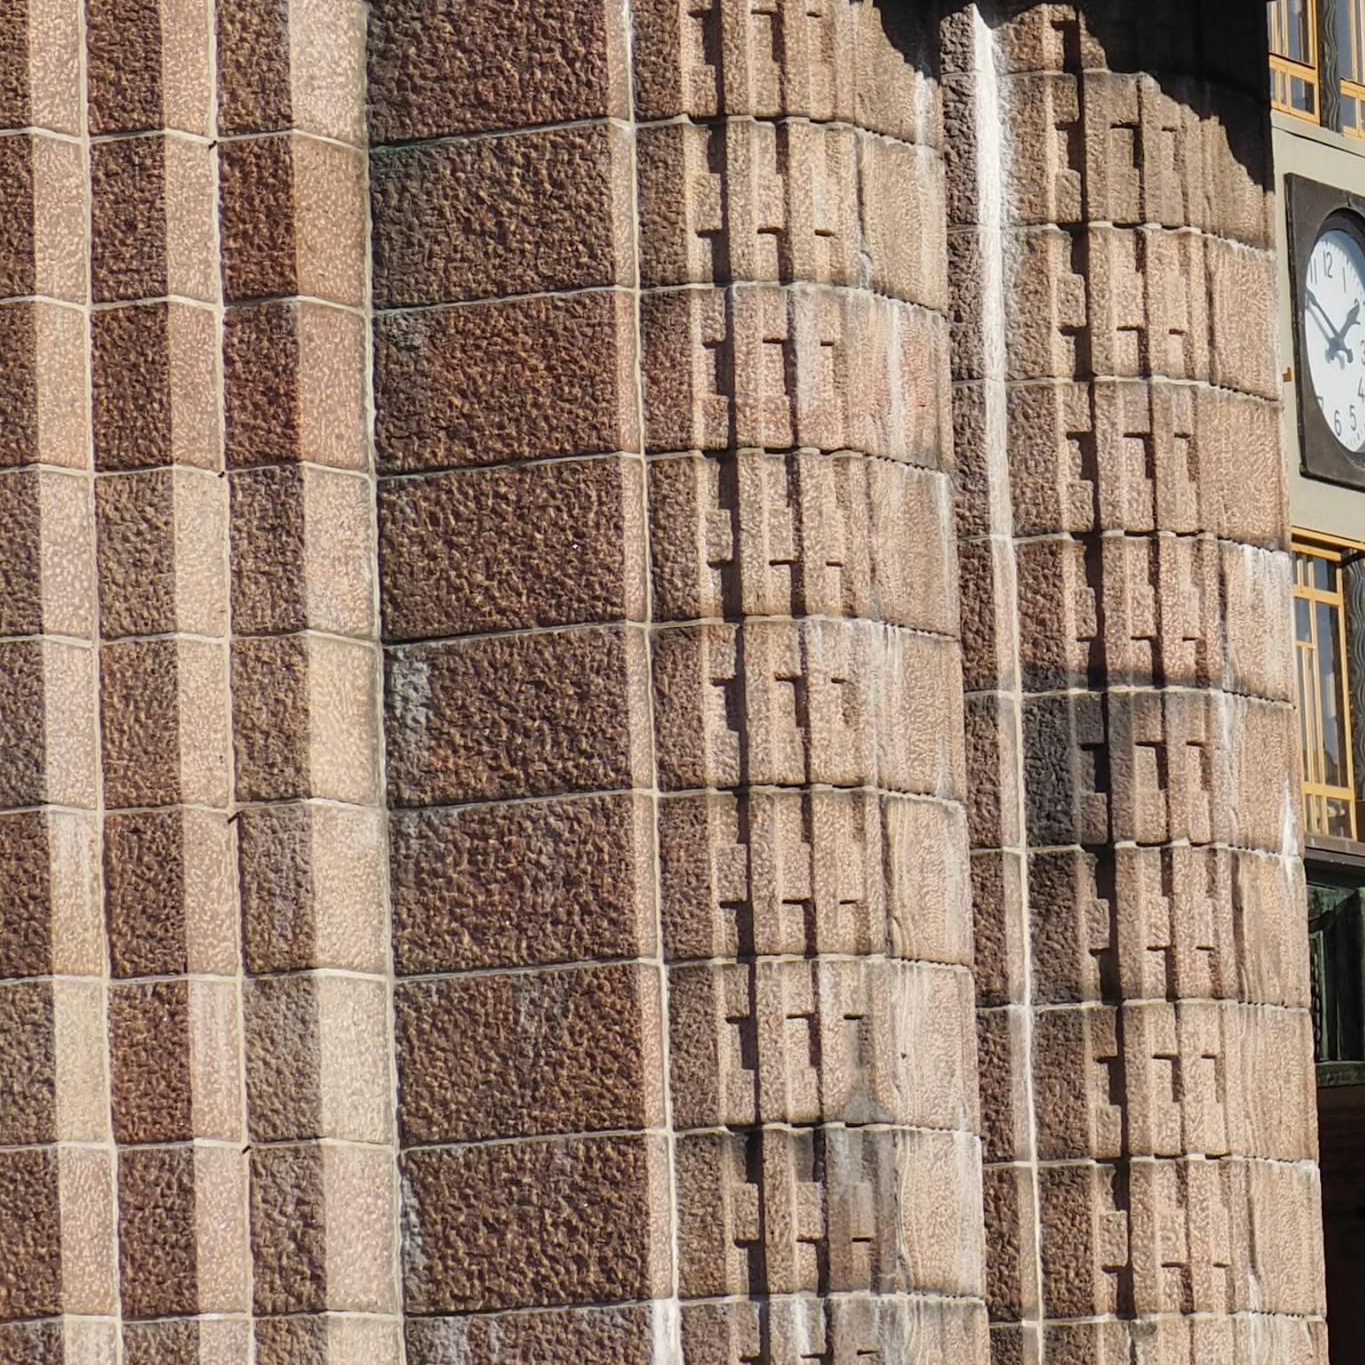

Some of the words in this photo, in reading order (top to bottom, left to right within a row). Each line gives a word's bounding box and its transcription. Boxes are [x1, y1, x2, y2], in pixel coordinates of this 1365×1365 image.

[1322, 250, 1334, 278] 12
[1357, 377, 1365, 403] 4
[1333, 409, 1342, 437] 6
[1349, 404, 1357, 431] 5
